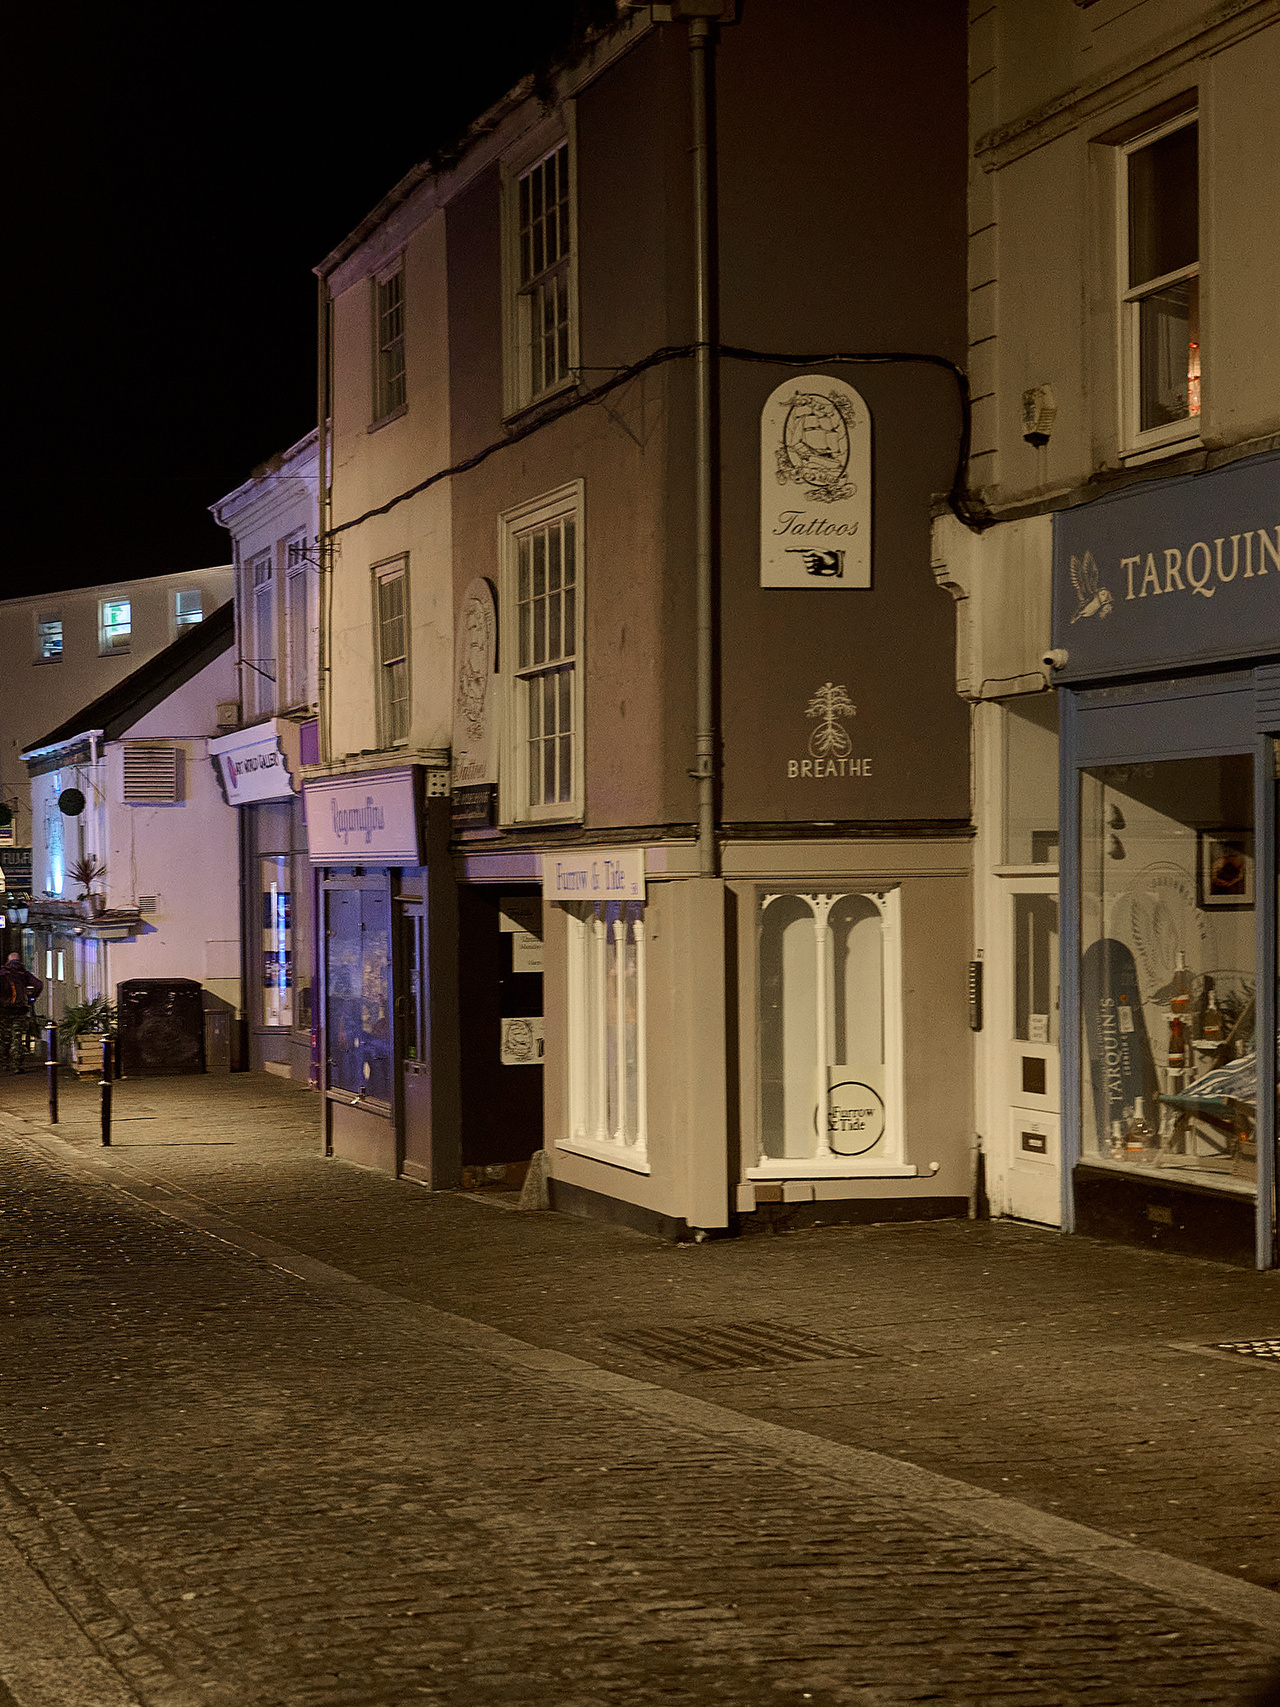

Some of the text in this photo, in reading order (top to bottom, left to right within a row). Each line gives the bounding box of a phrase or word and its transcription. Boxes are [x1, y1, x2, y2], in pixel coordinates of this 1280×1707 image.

[773, 510, 859, 536] Tattoos
[244, 757, 259, 773] WORLD
[259, 752, 279, 770] GALLERY
[787, 758, 873, 779] BREATHE
[556, 862, 587, 891] Furrow
[592, 861, 601, 890] &
[604, 860, 625, 890] Tide
[1100, 997, 1123, 1105] TARQUIN'S
